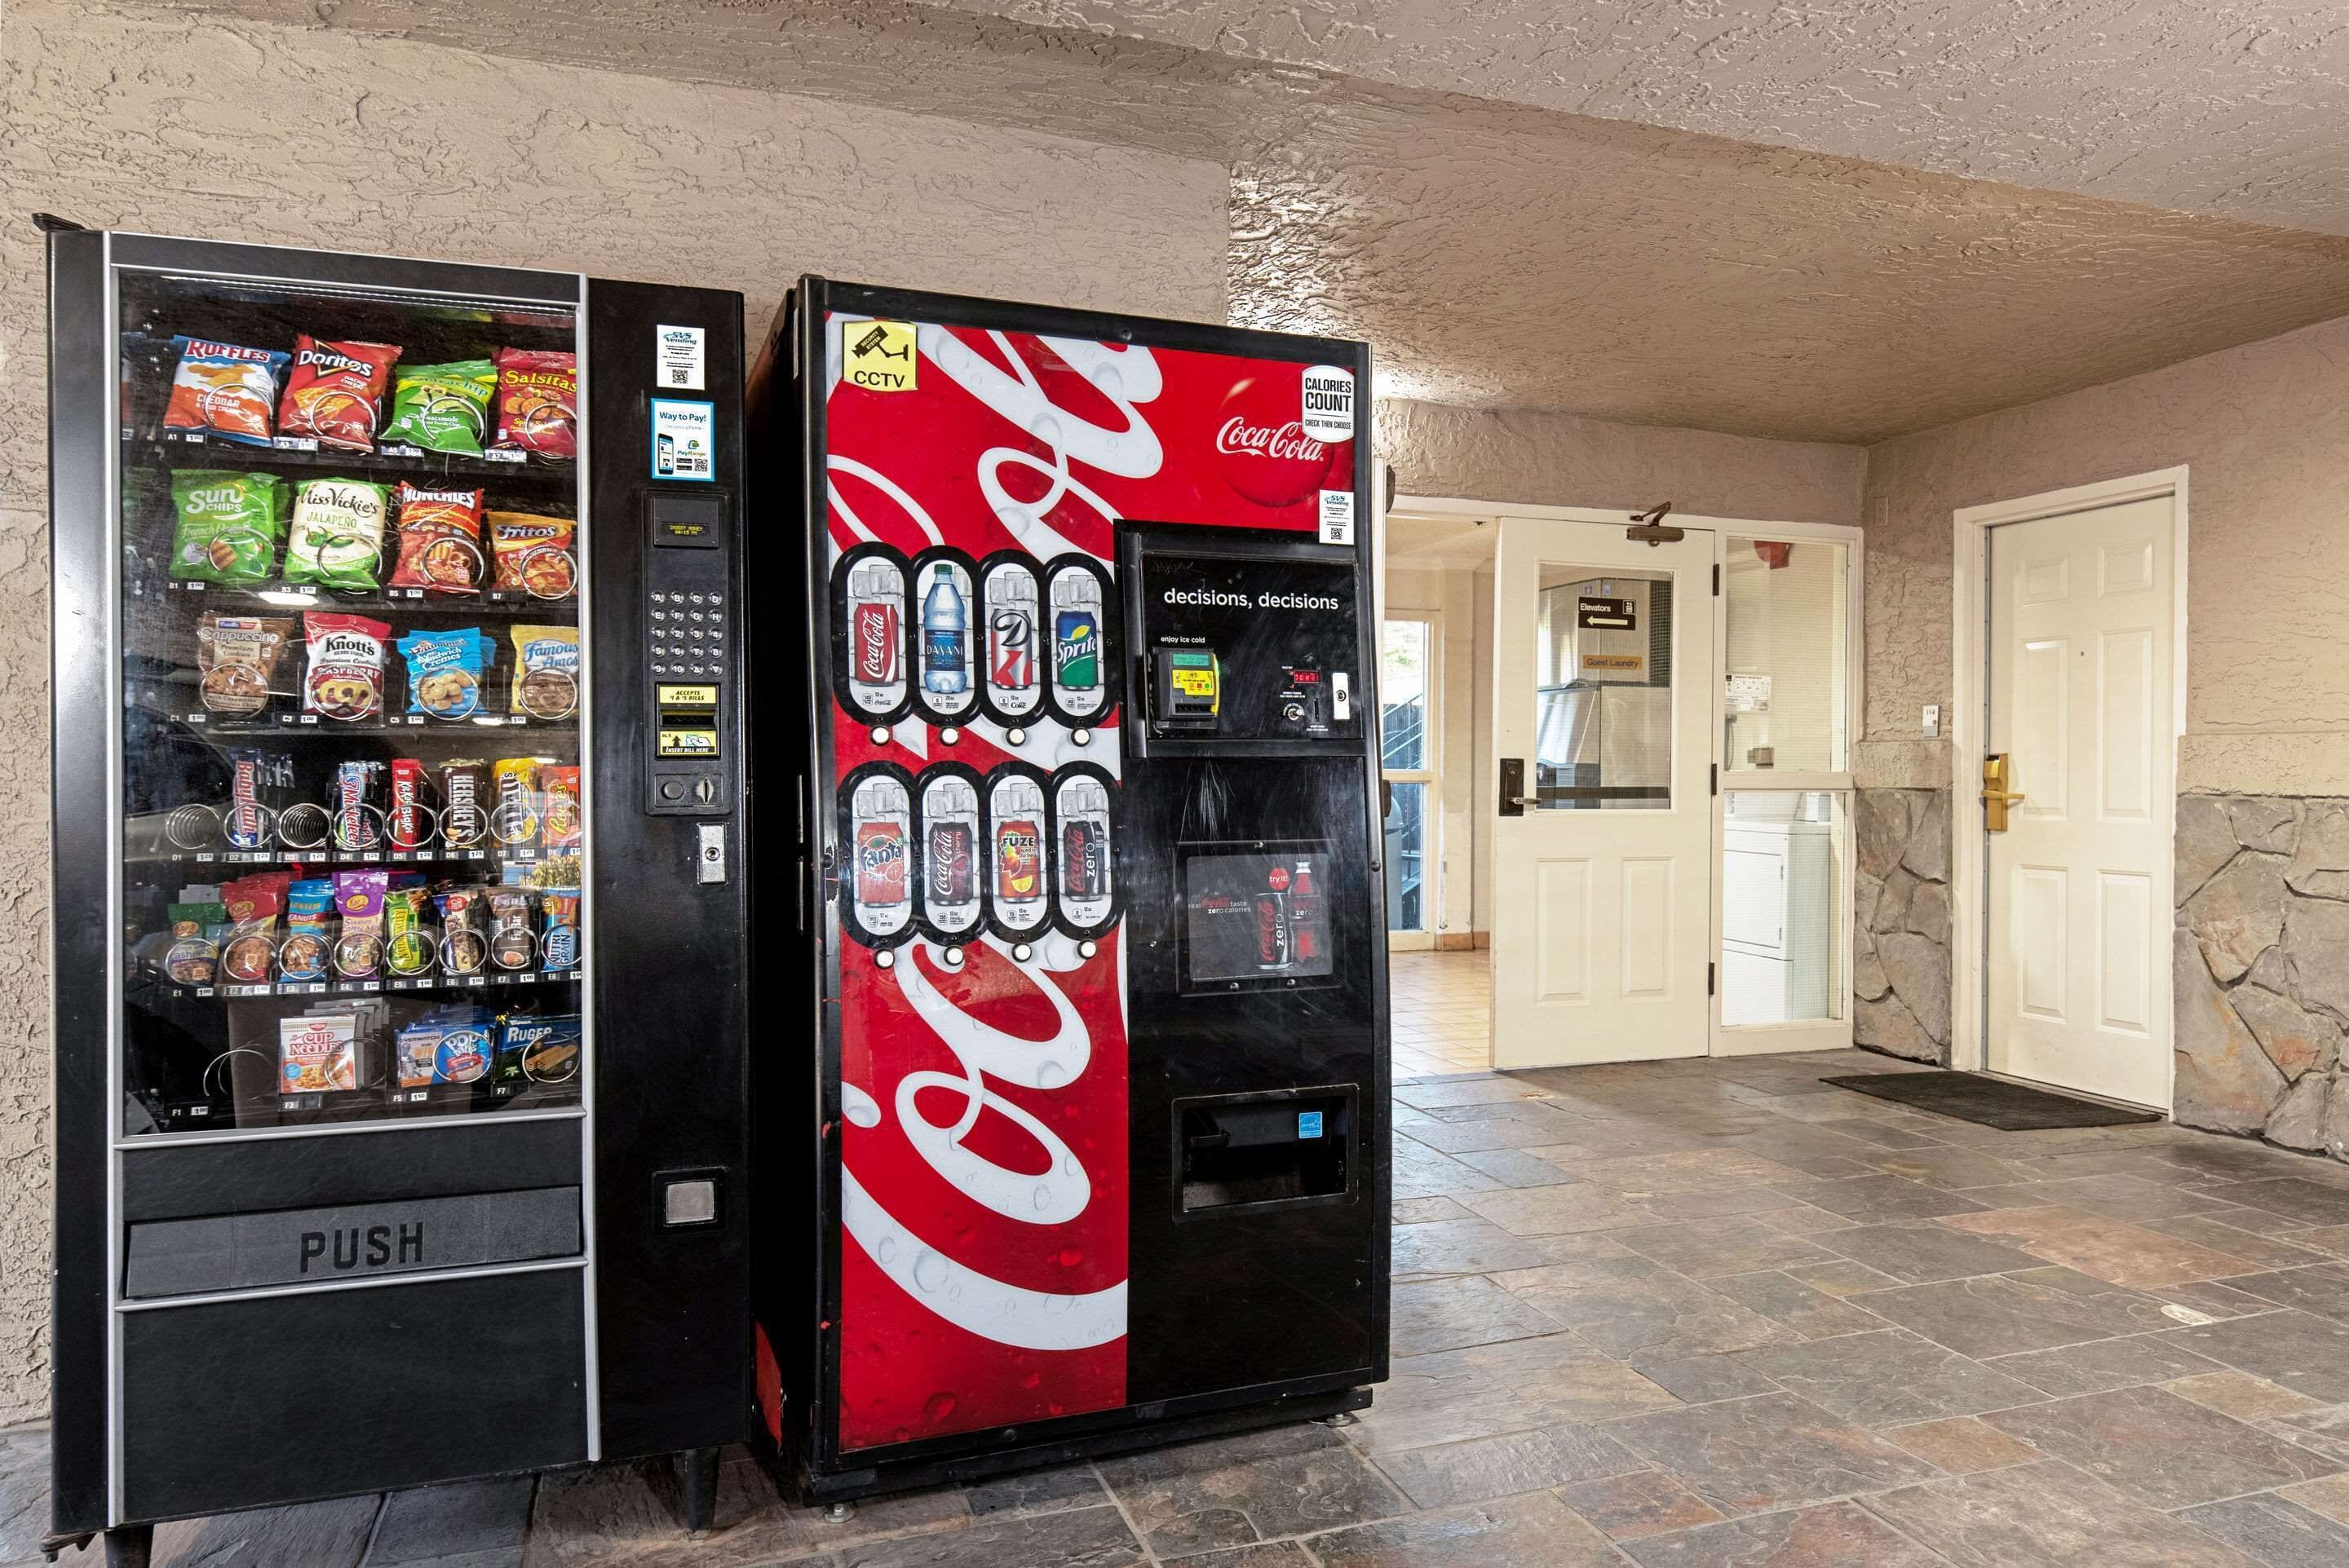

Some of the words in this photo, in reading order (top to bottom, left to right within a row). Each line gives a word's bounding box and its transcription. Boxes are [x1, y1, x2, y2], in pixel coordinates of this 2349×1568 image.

[666, 337, 697, 345] Vending
[860, 331, 879, 347] SECURITY
[866, 336, 882, 351] SYSTEM
[184, 338, 272, 363] RUFFLES
[298, 350, 374, 378] Doritos
[506, 370, 577, 392] Salsitas
[854, 370, 905, 388] CCTV
[1304, 377, 1351, 394] CALORIES
[1304, 391, 1351, 413] COUNT
[659, 412, 678, 422] Way
[689, 413, 706, 423] Pay!
[1305, 419, 1320, 428] CHECK
[1321, 419, 1334, 429] THEN
[1334, 420, 1351, 430] CHOOSE
[185, 488, 243, 514] Sun
[206, 502, 242, 512] CHIPS
[402, 487, 476, 510] MUNCHIES
[307, 511, 357, 528] JALAPEÑO
[1163, 587, 1253, 610] decisions,
[1258, 591, 1339, 610] decisions
[1580, 603, 1612, 612] Elevators
[198, 627, 280, 644] Cappuccino
[1160, 635, 1179, 643] enjoy
[325, 635, 376, 656] Knott's
[523, 642, 579, 662] Famous
[926, 643, 964, 656] DASANI
[1057, 635, 1097, 665] Sprite
[542, 656, 579, 666] Amos
[1586, 658, 1608, 666] Guest
[1609, 659, 1639, 669] Laundry
[452, 775, 476, 838] HERSHEY'S
[343, 786, 362, 847] Musketeer
[1002, 837, 1036, 846] FUZE
[860, 840, 903, 873] Fanta
[1086, 841, 1095, 877] zero
[1281, 874, 1289, 882] it!
[1188, 902, 1201, 910] real
[1224, 905, 1251, 913] calories
[287, 913, 317, 921] EANUTS
[511, 914, 522, 927] Bar
[1275, 913, 1285, 947] zero
[550, 934, 561, 965] NUTRI
[560, 934, 571, 965] GRAIN
[303, 1032, 334, 1044] CUP
[299, 1223, 425, 1274] PUSH
